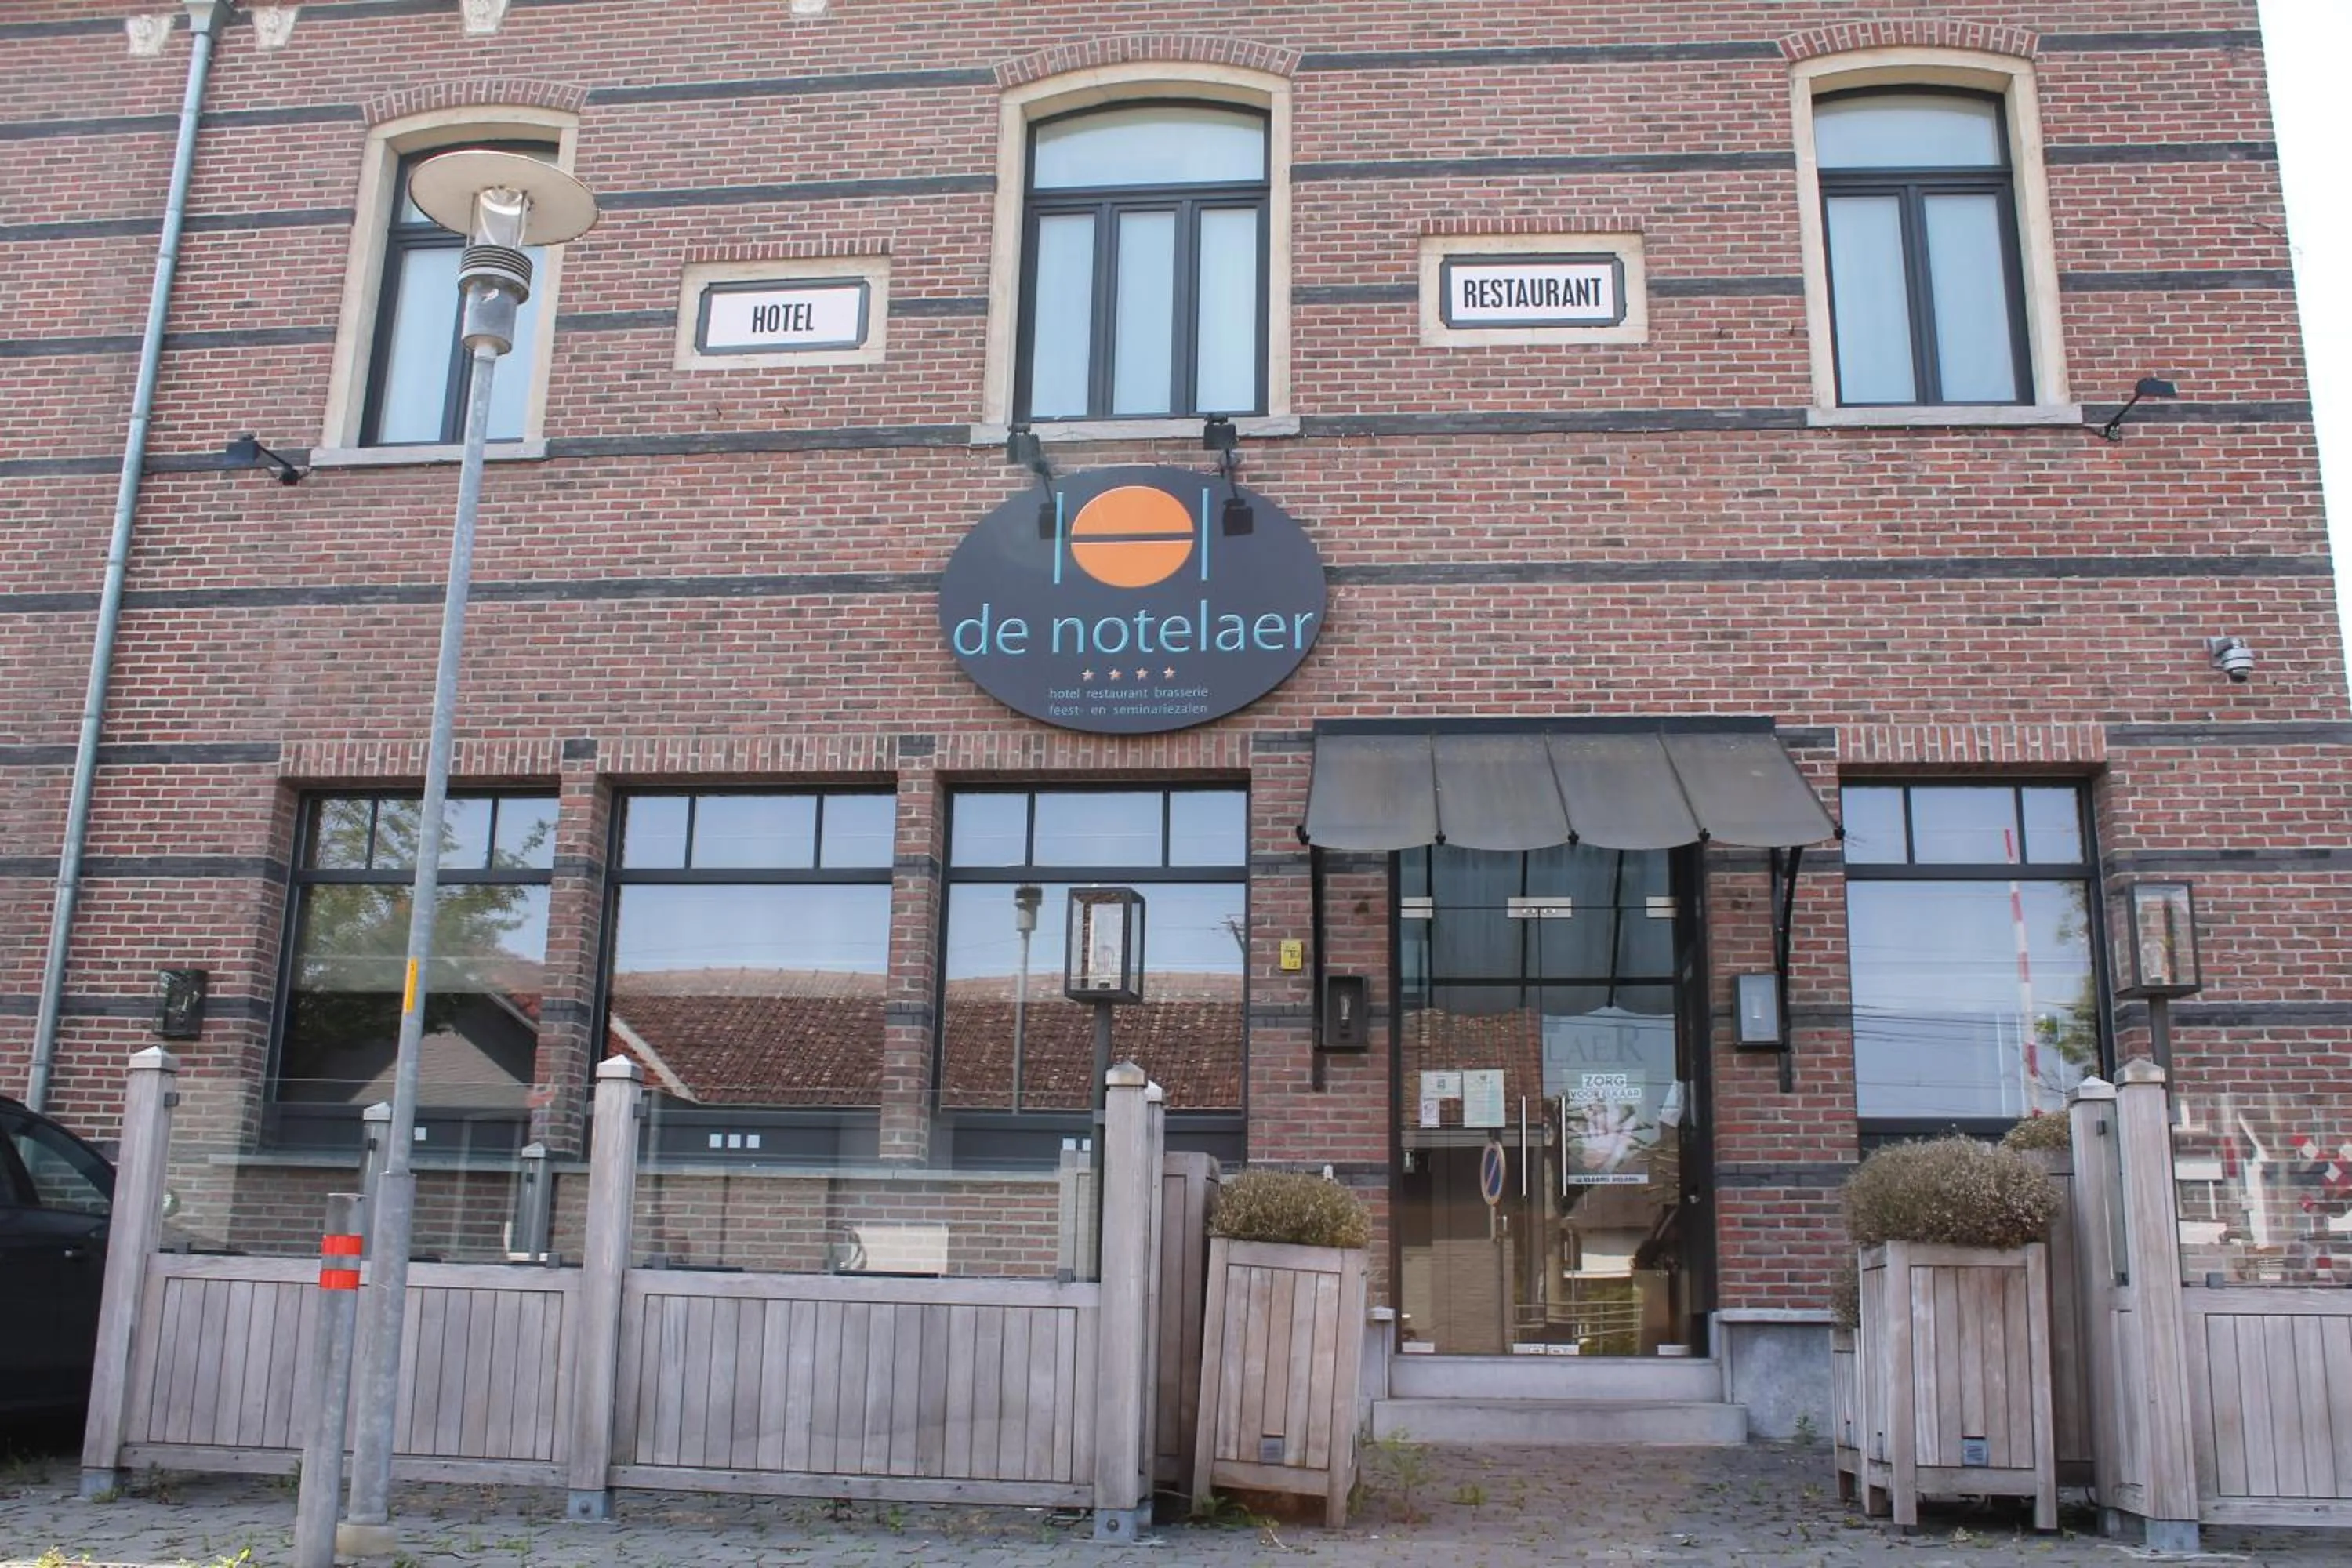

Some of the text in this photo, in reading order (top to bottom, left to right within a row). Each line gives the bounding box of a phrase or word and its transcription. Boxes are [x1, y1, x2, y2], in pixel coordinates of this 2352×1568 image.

[1464, 278, 1602, 308] RESTAURANT
[752, 303, 814, 333] HOTEL
[953, 598, 1314, 655] de notelaer
[1049, 686, 1209, 699] hotel restaurant brasserie
[1091, 706, 1107, 716] en
[1112, 702, 1208, 716] seminariezalen
[1584, 1075, 1626, 1087] ZORG
